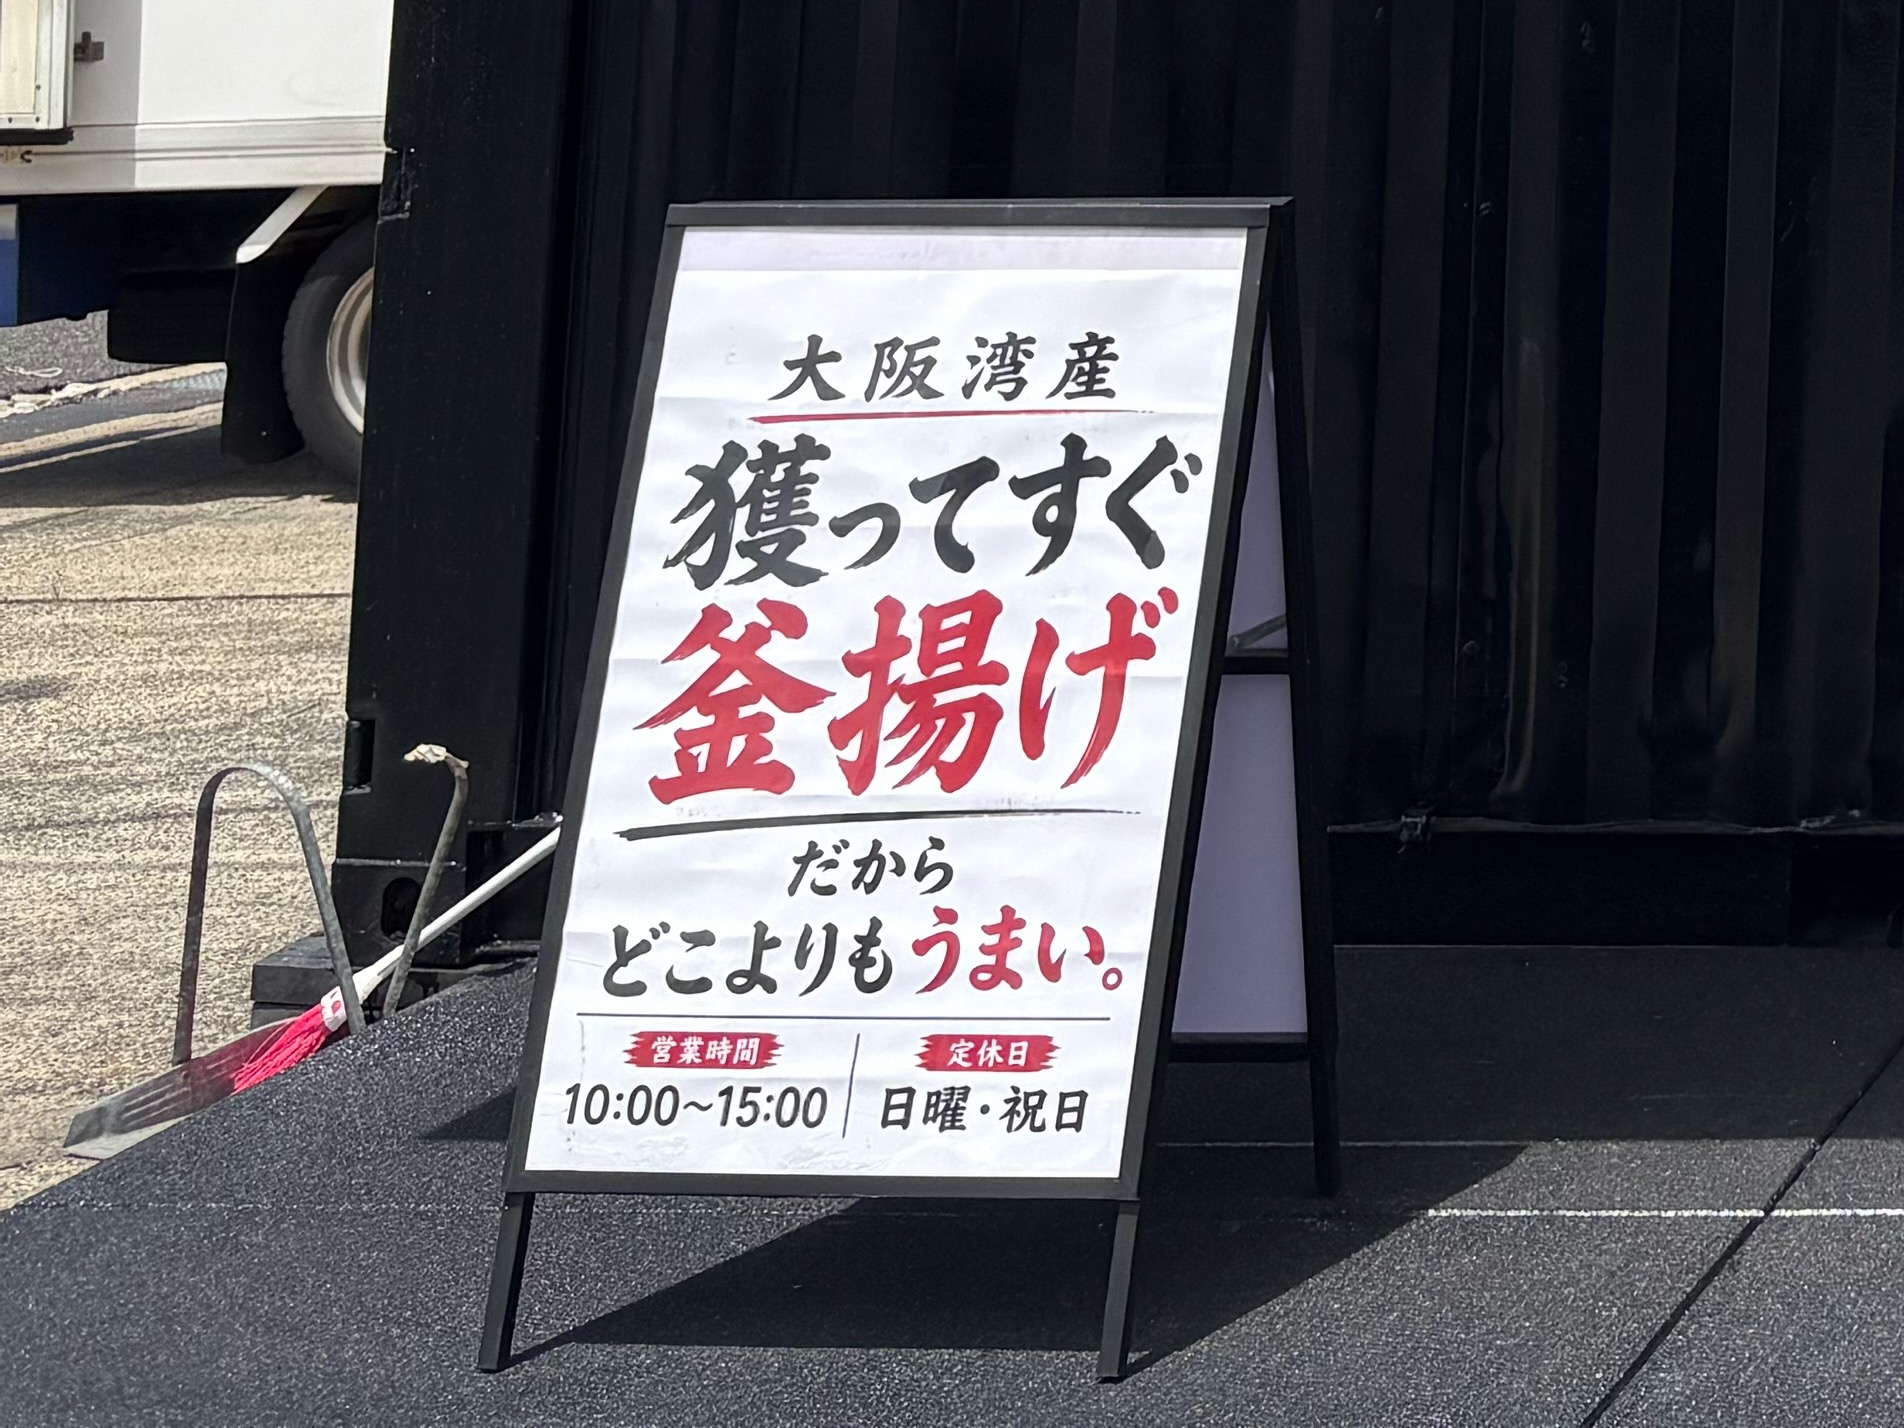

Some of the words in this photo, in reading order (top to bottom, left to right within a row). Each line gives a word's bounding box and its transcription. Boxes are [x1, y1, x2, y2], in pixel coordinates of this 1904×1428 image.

[768, 330, 1120, 404] 大阪湾産
[661, 431, 1204, 590] 獲ってすぐ
[635, 587, 1179, 805] 釜揚げ
[786, 835, 955, 898] だから
[602, 904, 1124, 999] どこよりもうまい。
[650, 1035, 761, 1066] 営業時間
[946, 1038, 1030, 1068] 定休日
[879, 1084, 1090, 1135] 日曜・祝日
